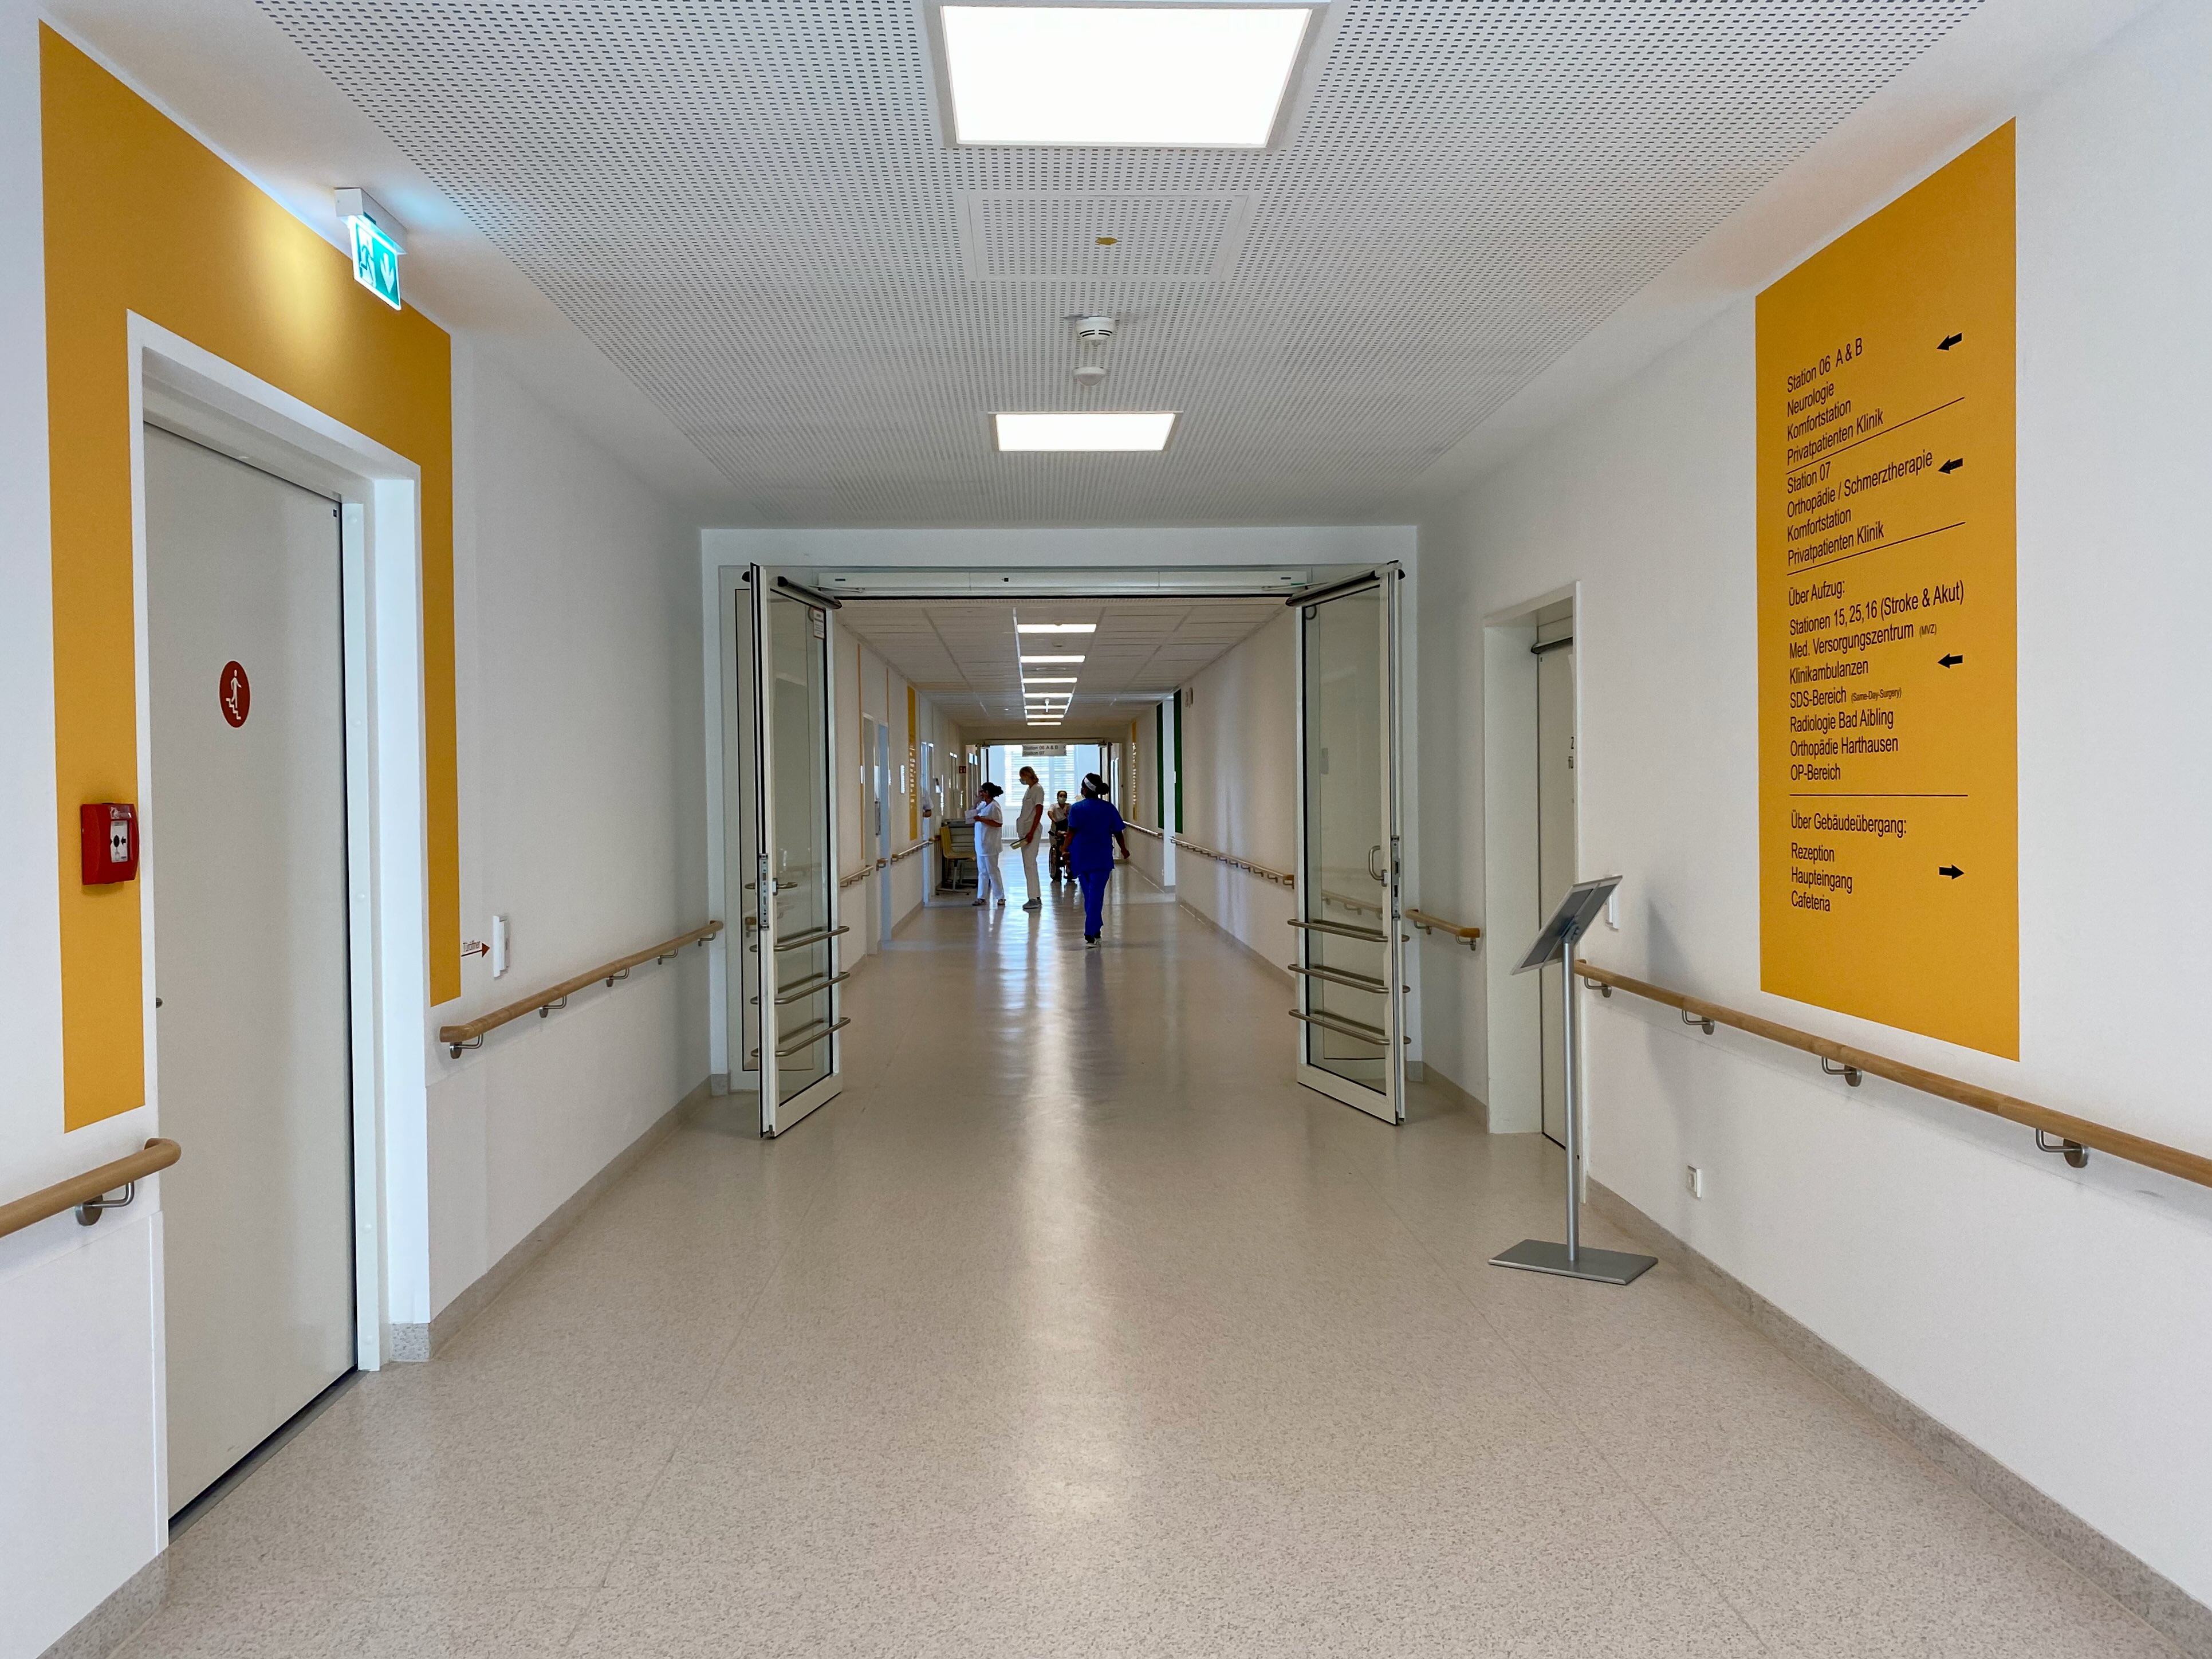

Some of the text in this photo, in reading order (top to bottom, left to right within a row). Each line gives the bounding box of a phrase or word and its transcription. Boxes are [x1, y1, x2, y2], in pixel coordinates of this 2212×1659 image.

[1787, 337, 1863, 393] Station 06 A & B
[1787, 382, 1835, 417] Neurologie
[1787, 400, 1851, 441] Komfortstation
[1787, 408, 1884, 466] Privatpatienten Klinik
[1787, 462, 1831, 494] Station 07
[1787, 449, 1932, 517] Orthopädie / Schmerztherapie
[1787, 508, 1851, 542] Komfortstation
[1788, 521, 1884, 566] Privatpatienten Klinik
[1788, 580, 1845, 606] Über Aufzug:
[1790, 580, 1964, 635] Stationen 15, 25, 16 (Stroke & Akut)
[1789, 623, 1937, 659] Med. Versorgungszentrum (MVZ)
[1790, 660, 1868, 684] Klinikambulanzen
[1790, 687, 1902, 709] SDS-Bereich (Same-Day-Surgery)
[1790, 708, 1894, 734] Radiologie Bad Aibling
[1790, 736, 1898, 760] Orthopädie Harthausen
[1790, 764, 1841, 781] OP-Bereich
[1791, 809, 1907, 839] Über Gebäudeübergang:
[1791, 842, 1835, 864] Rezeption
[1791, 866, 1853, 894] Haupteingang
[1791, 890, 1831, 911] Cafeteria
